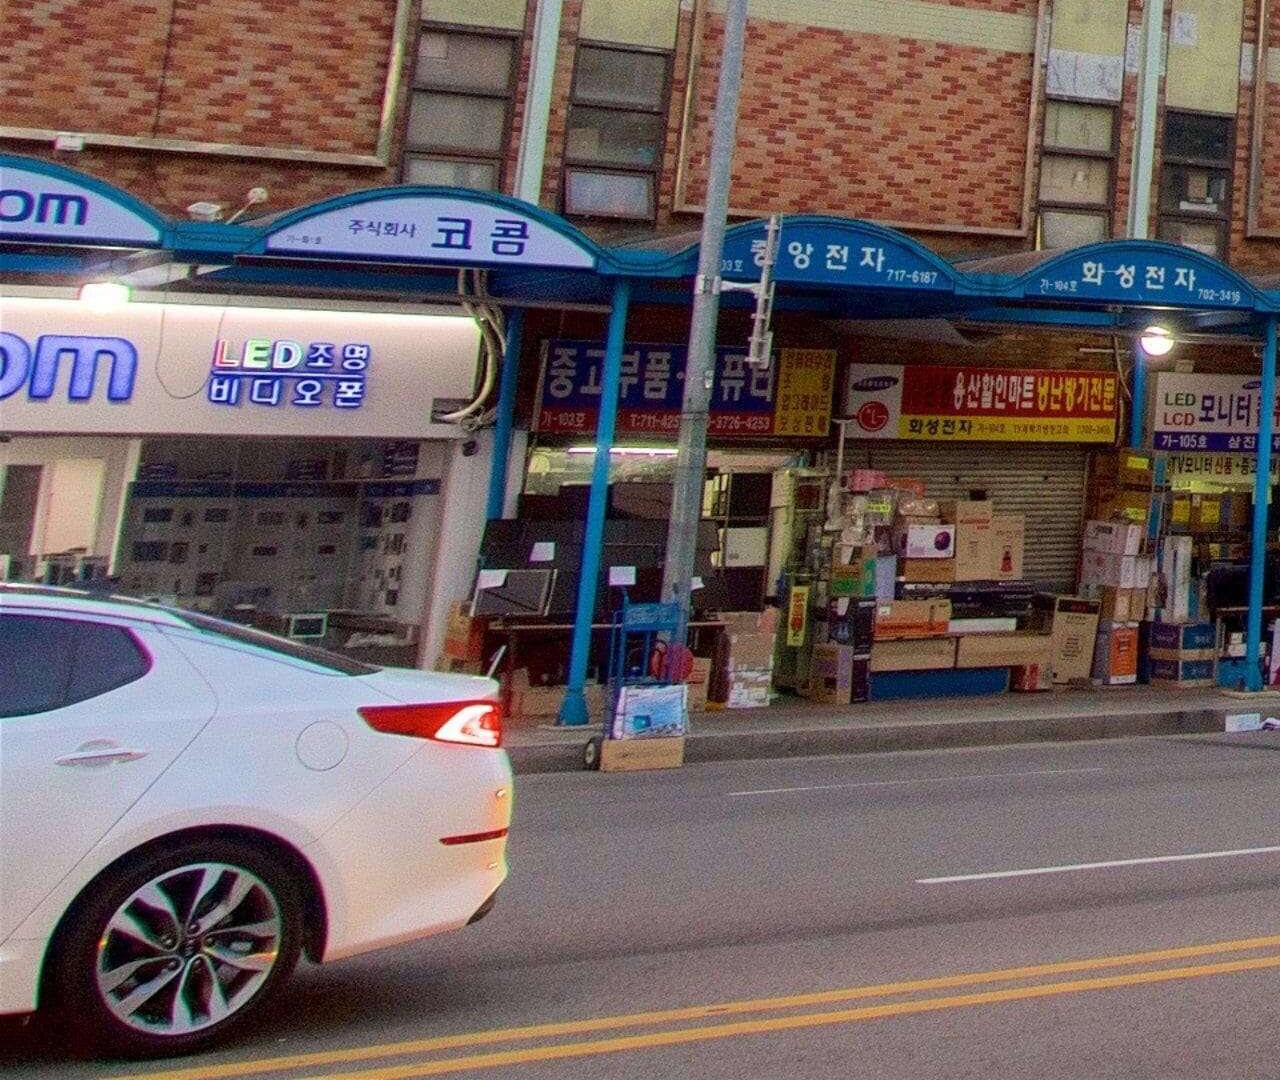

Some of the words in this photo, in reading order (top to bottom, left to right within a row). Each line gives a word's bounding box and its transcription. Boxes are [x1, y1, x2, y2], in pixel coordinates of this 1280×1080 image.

[348, 219, 417, 240] 주식회사
[430, 215, 531, 257] 코콤
[749, 239, 886, 273] 중앙전자
[1081, 260, 1197, 292] 화성전자
[212, 338, 371, 370] LED조명
[208, 377, 366, 408] 비디오폰
[1163, 392, 1196, 407] LED
[1162, 412, 1195, 426] LCD
[1198, 394, 1253, 427] 모니터
[908, 419, 973, 436] 화성전자
[1160, 434, 1208, 449] 가-105호
